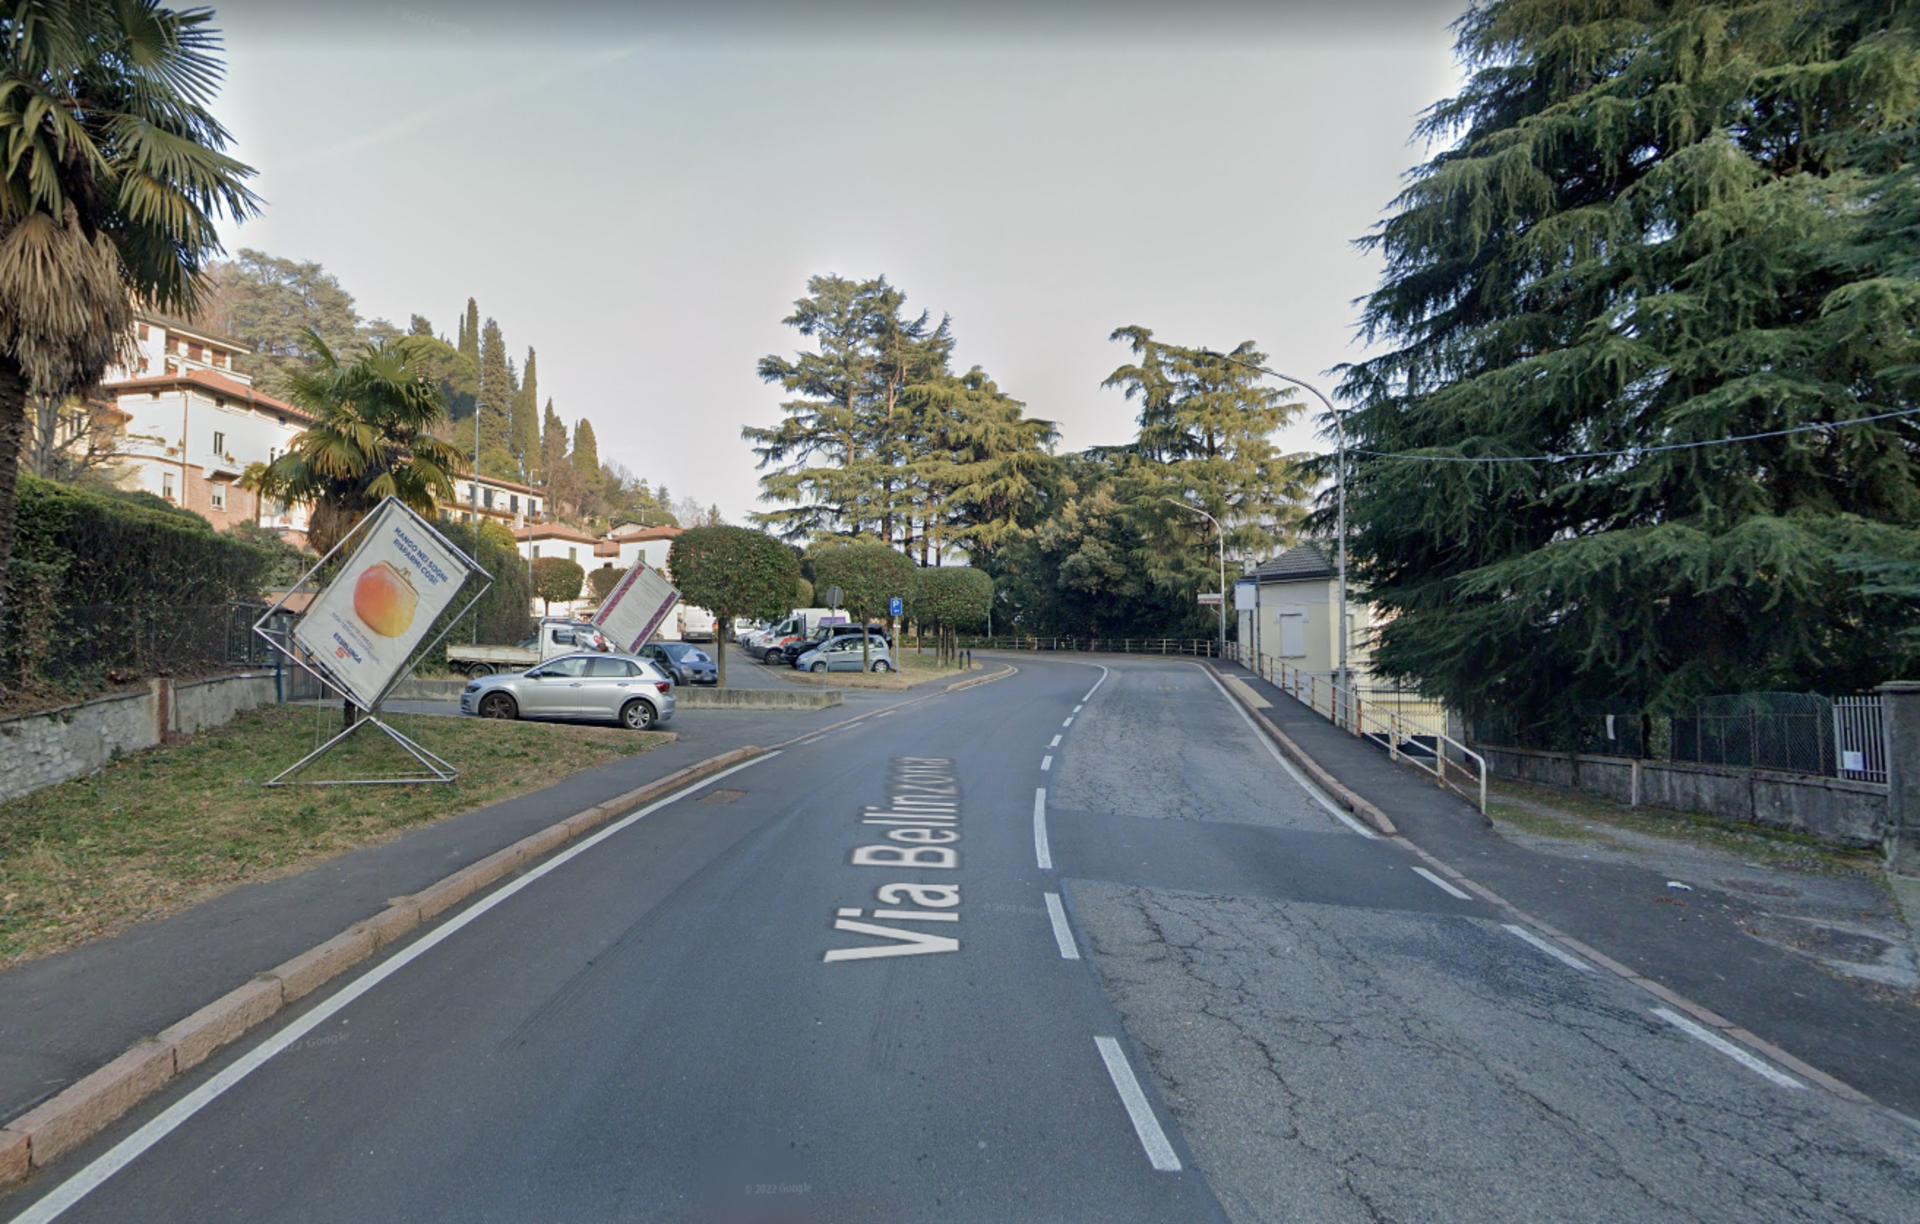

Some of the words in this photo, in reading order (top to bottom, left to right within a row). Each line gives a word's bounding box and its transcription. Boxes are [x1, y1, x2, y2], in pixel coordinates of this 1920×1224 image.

[393, 538, 422, 569] RISPARMI
[394, 527, 418, 552] MANGO
[417, 549, 430, 563] NEI
[428, 560, 448, 583] SOGNI
[852, 756, 960, 869] Bellinzona
[823, 882, 960, 963] Via
